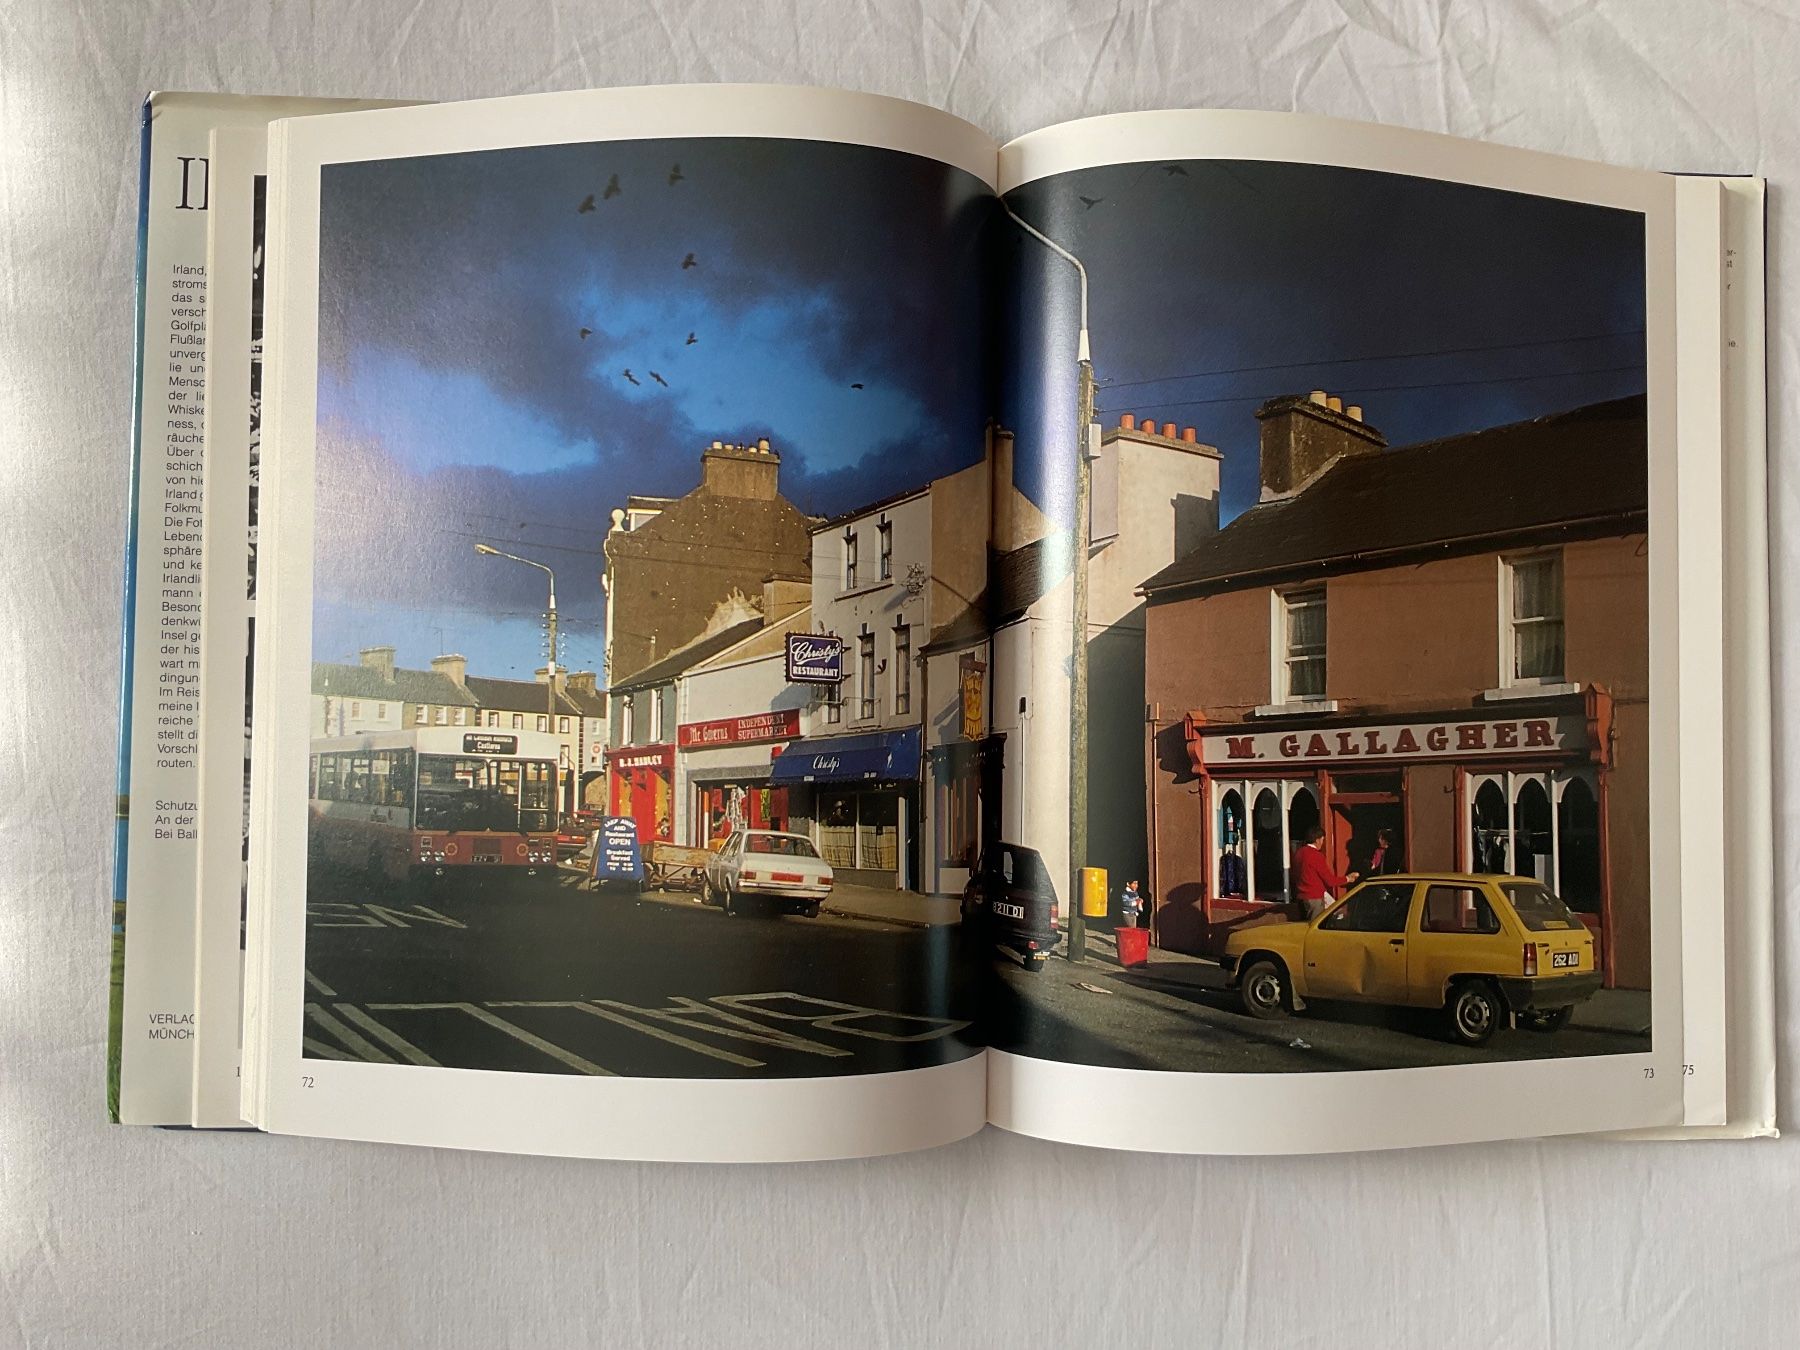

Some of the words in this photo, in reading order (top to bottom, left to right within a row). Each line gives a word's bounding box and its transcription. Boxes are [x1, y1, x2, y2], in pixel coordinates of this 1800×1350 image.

[172, 263, 207, 277] Irland,
[171, 292, 193, 303] das
[169, 362, 182, 373] lie
[190, 364, 205, 373] un
[168, 390, 188, 401] der
[167, 420, 197, 430] ness,
[166, 444, 195, 457] Über
[165, 476, 186, 485] von
[165, 488, 197, 500] Irland
[164, 516, 183, 527] Die
[163, 559, 184, 570] und
[161, 588, 194, 598] mann
[160, 629, 187, 641] Insel
[160, 644, 179, 654] der
[159, 659, 184, 669] wart
[792, 665, 839, 677] RESTAURANT
[159, 686, 173, 697] Im
[158, 701, 193, 711] meine
[158, 715, 193, 726] reiche
[157, 729, 184, 740] stellt
[738, 724, 788, 740] SUPERMARKET
[1225, 736, 1265, 759] M.
[1279, 720, 1555, 758] GALLAGHER
[157, 758, 196, 768] routen.
[155, 814, 171, 825] An
[175, 814, 194, 825] der
[155, 828, 173, 839] Bei
[608, 838, 631, 846] OPEN
[1643, 1067, 1655, 1079] 73
[1682, 1064, 1694, 1076] 75
[302, 1076, 314, 1088] 72
